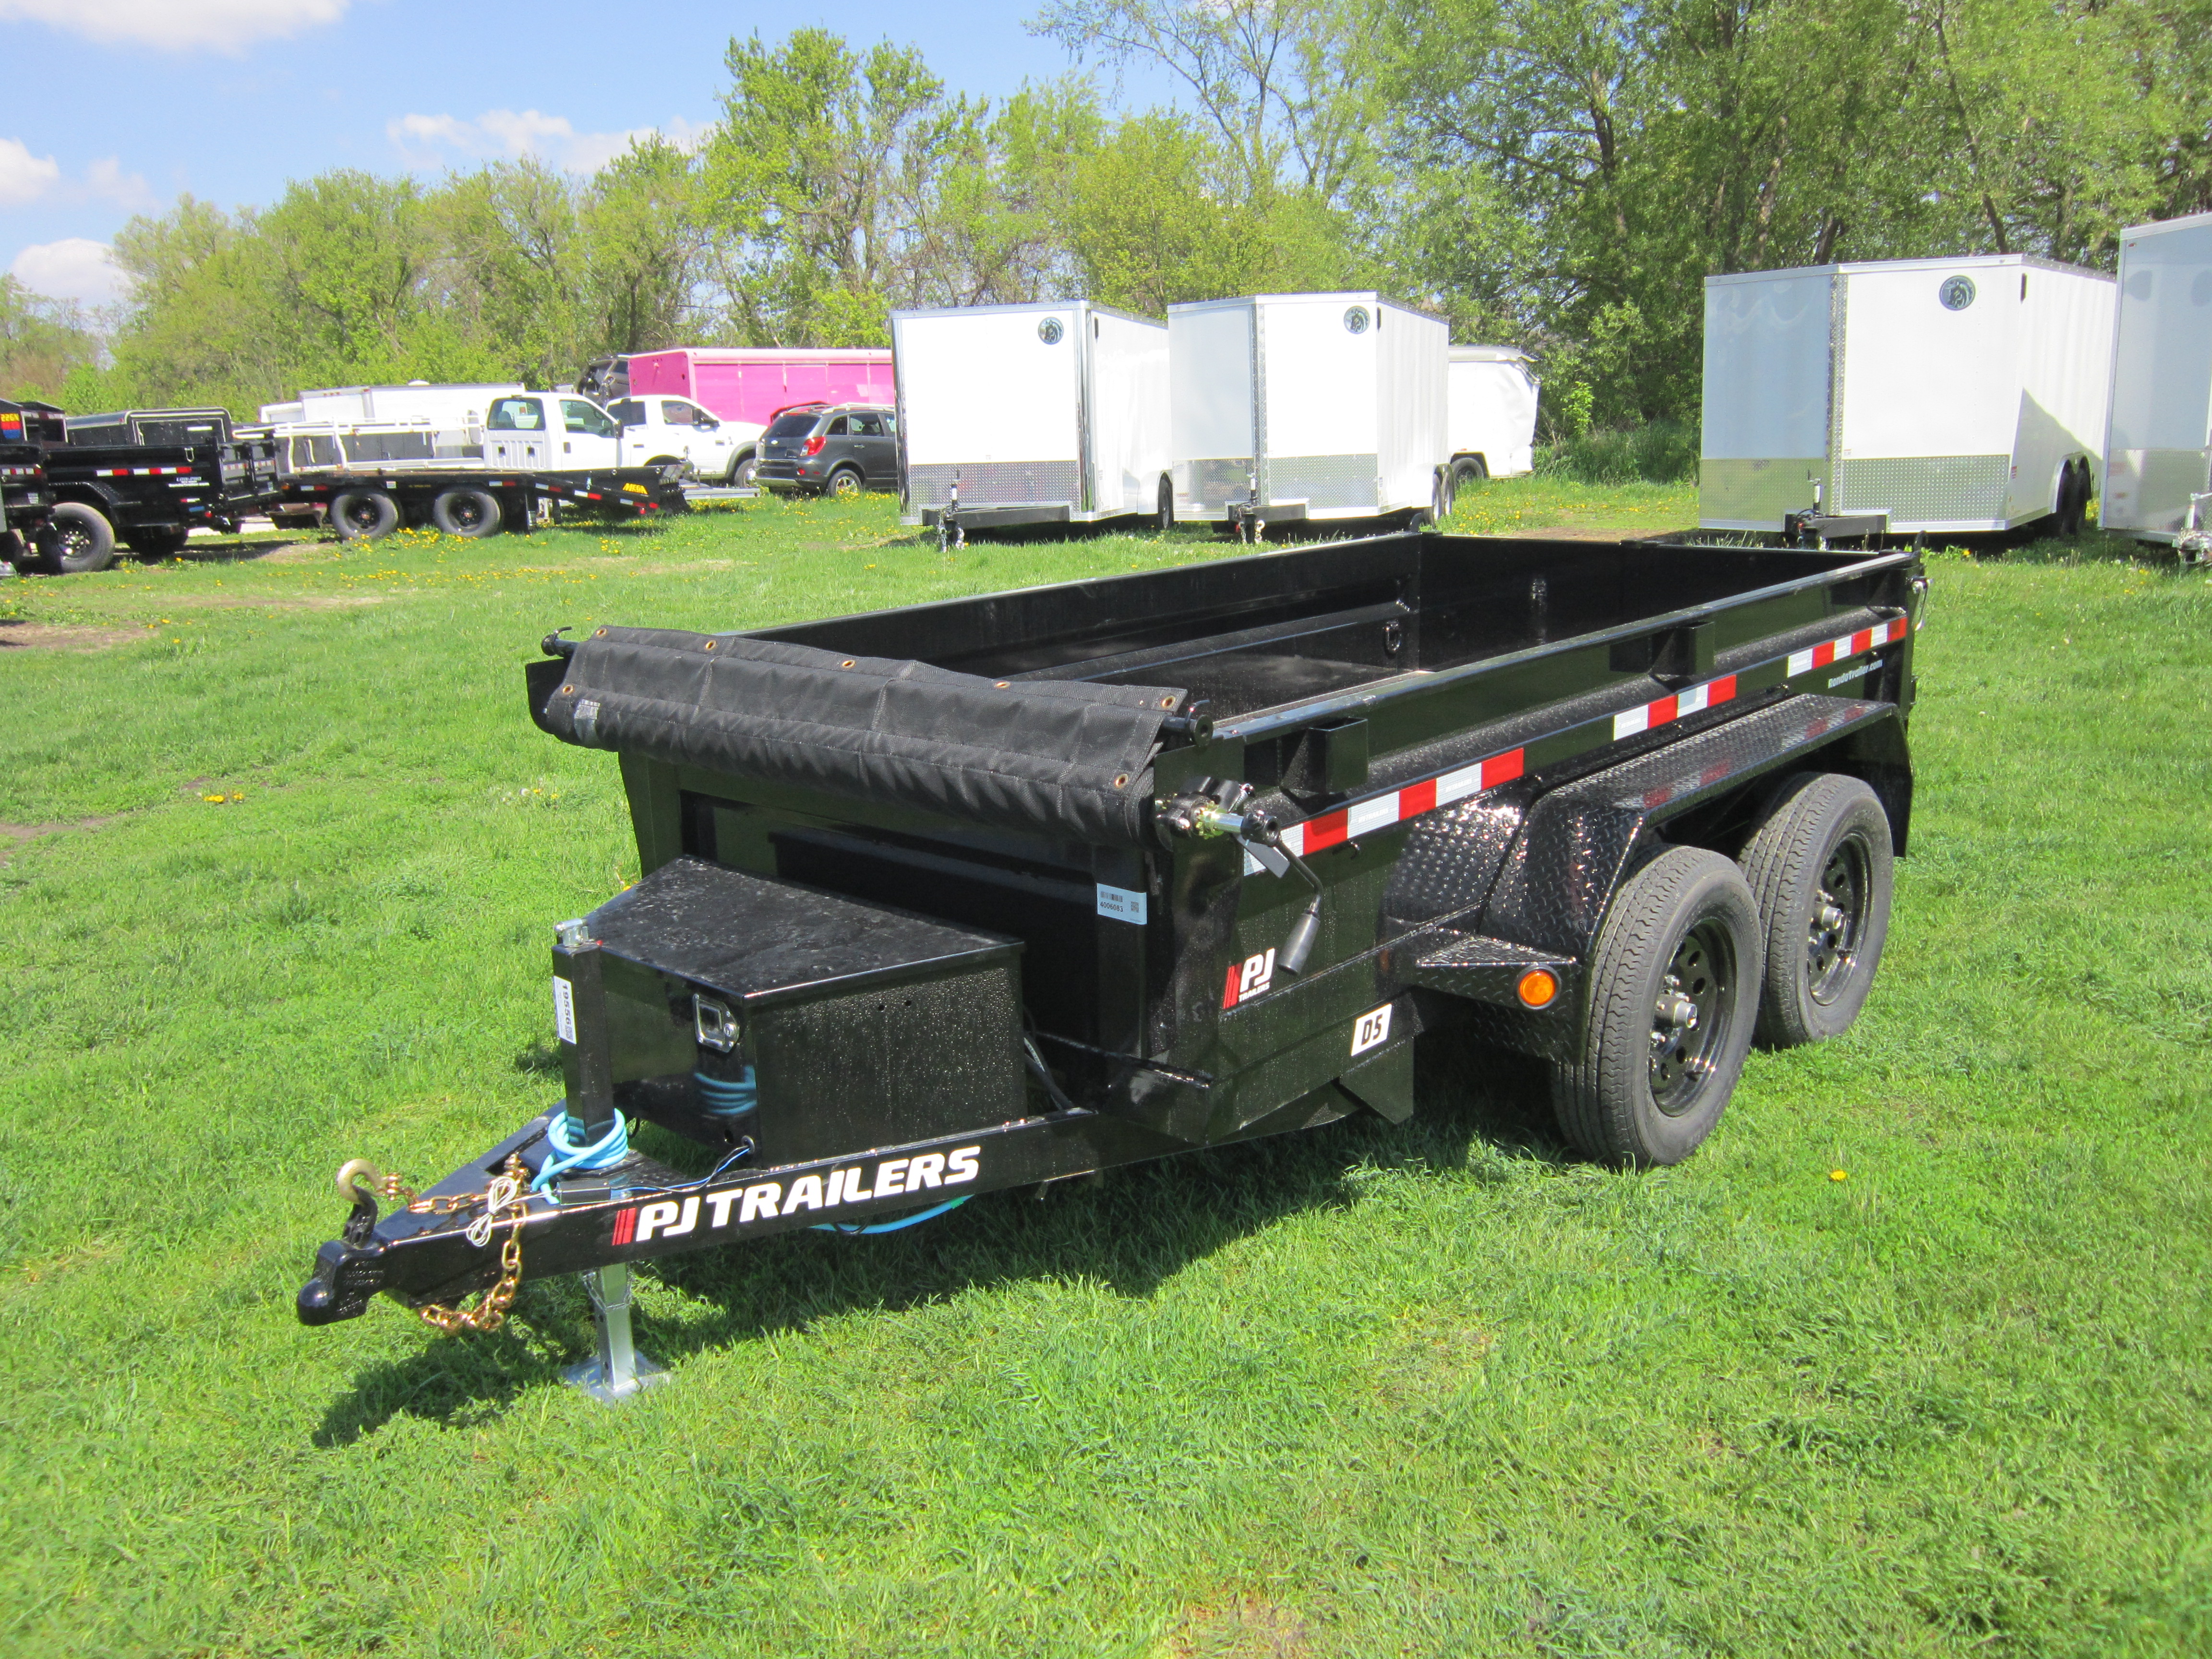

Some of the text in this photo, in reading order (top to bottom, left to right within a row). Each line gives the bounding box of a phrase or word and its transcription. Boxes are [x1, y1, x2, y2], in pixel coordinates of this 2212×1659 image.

[622, 482, 648, 494] MEGA
[1827, 659, 1883, 689] RondoTrailer.com
[1100, 901, 1124, 913] 4006083
[1239, 948, 1275, 993] PJ
[562, 983, 572, 1026] 19556
[1238, 981, 1270, 1002] TRAILERS
[1360, 1013, 1383, 1046] D5
